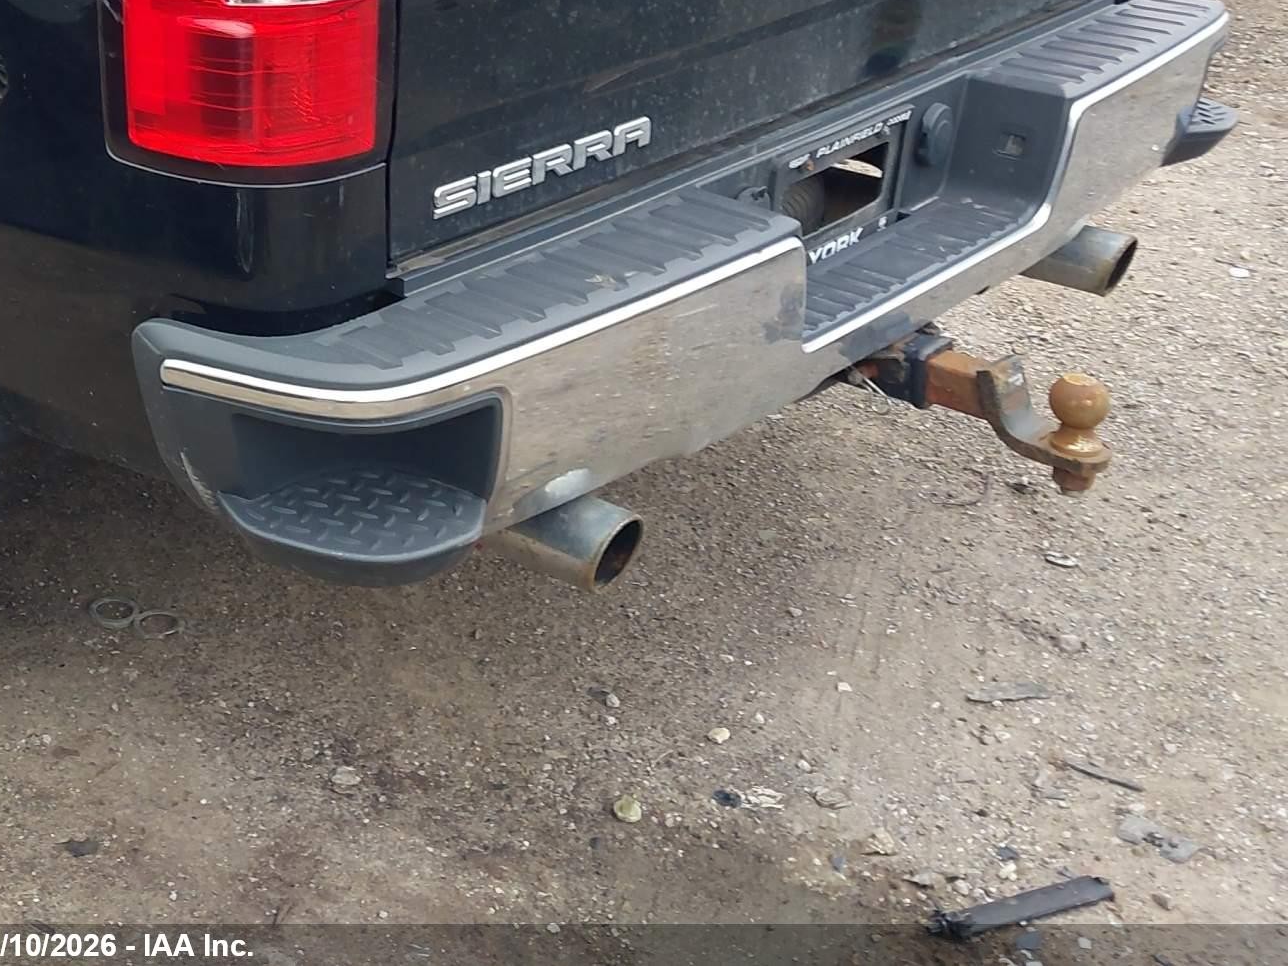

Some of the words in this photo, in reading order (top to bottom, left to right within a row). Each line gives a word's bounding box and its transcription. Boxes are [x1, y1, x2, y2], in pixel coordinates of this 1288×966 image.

[816, 122, 884, 158] PLAINFIELD
[432, 115, 651, 220] SIERRA
[808, 227, 864, 264] YORK
